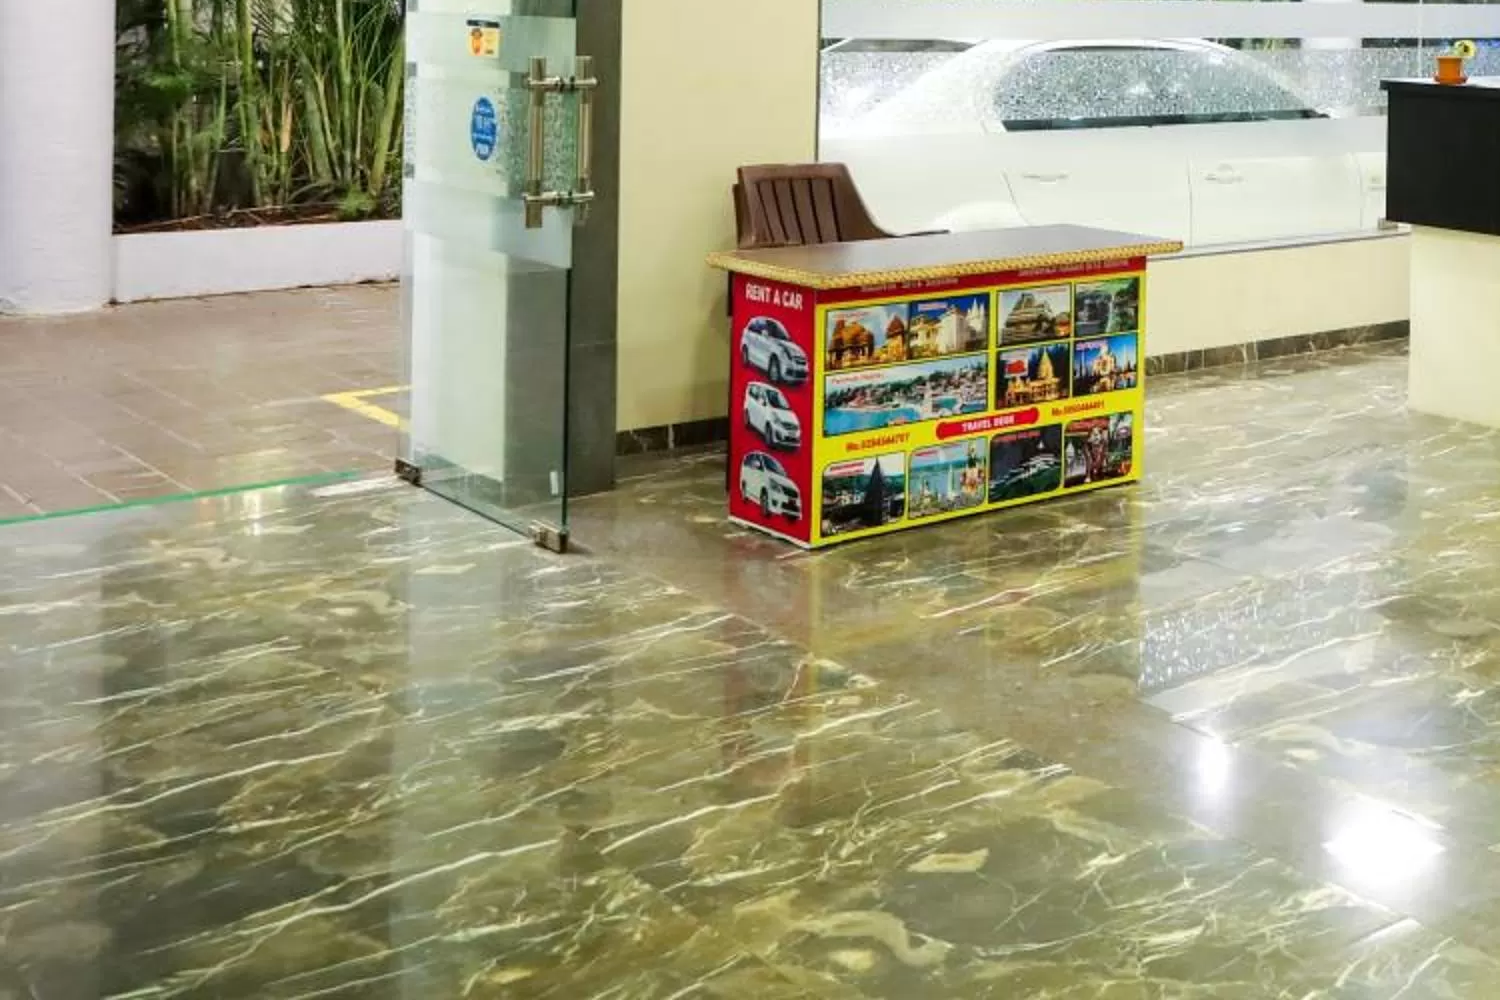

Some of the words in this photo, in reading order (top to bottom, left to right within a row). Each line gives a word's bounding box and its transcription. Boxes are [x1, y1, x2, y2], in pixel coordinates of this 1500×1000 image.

[745, 283, 771, 303] RENT
[773, 288, 781, 306] A
[782, 290, 803, 311] CAR
[962, 418, 992, 433] TRAVEL
